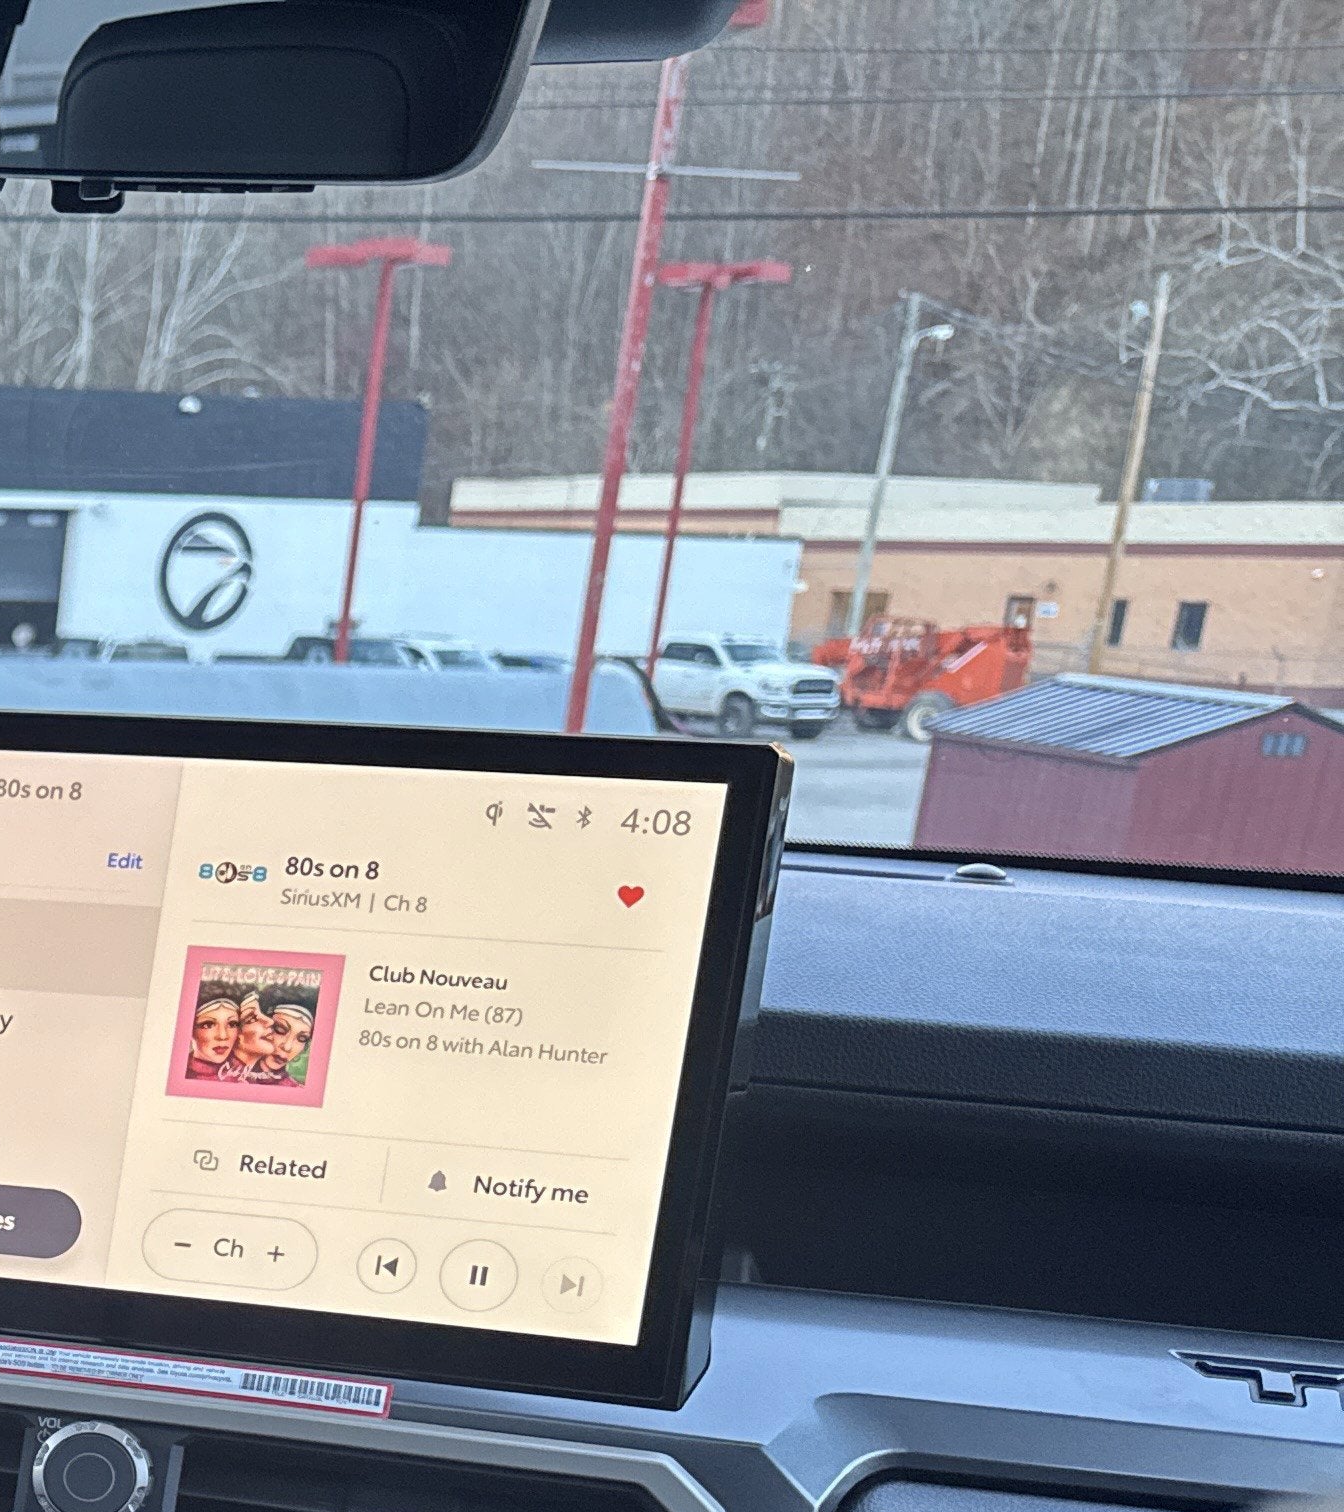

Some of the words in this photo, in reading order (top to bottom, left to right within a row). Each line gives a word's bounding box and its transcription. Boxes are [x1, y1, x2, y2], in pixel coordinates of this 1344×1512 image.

[35, 784, 64, 801] on
[68, 782, 83, 802] 8
[620, 808, 692, 836] 4:08
[107, 853, 144, 871] Edit
[285, 856, 324, 878] 80s
[329, 863, 359, 879] on
[365, 860, 380, 880] 8
[280, 888, 361, 909] SiriusXM
[383, 894, 410, 913] Ch
[415, 896, 428, 914] 8
[369, 965, 416, 987] Club
[420, 969, 509, 992] Nouveau
[364, 998, 410, 1020] Lean
[415, 1001, 446, 1022] On
[450, 1004, 480, 1024] Me
[484, 1005, 524, 1028] (87)
[359, 1029, 395, 1049] 80s
[398, 1036, 424, 1051] on
[427, 1033, 439, 1052] 8
[443, 1034, 484, 1056] with
[488, 1039, 534, 1060] Alan
[539, 1042, 609, 1066] Hunter
[239, 1154, 327, 1180] Related
[473, 1175, 546, 1205] Notify
[549, 1184, 590, 1205] me
[213, 1237, 244, 1259] Ch
[37, 1416, 63, 1430] VOL
